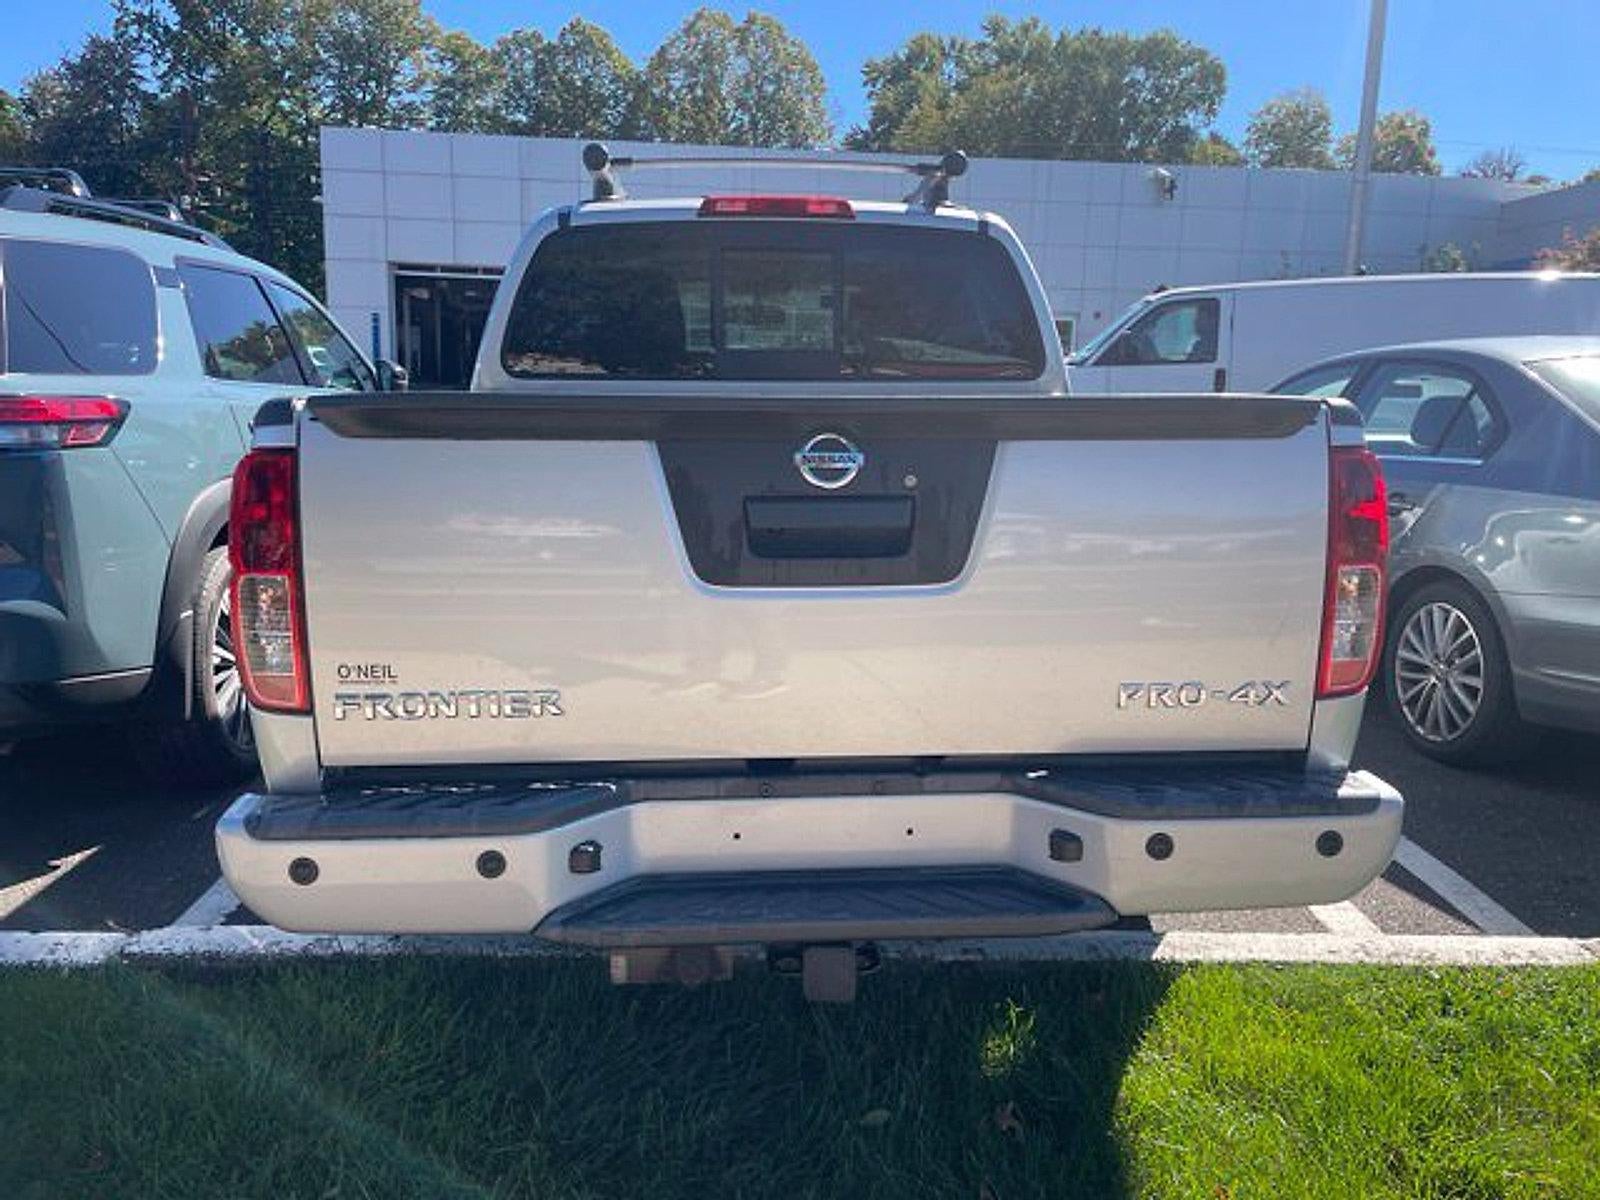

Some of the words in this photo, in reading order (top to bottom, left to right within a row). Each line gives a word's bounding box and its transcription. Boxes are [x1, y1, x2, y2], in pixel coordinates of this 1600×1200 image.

[799, 453, 858, 465] NISSAN
[337, 664, 398, 679] O'NEIL
[1118, 680, 1291, 708] PRO-4X
[334, 690, 564, 720] FRONTIER
